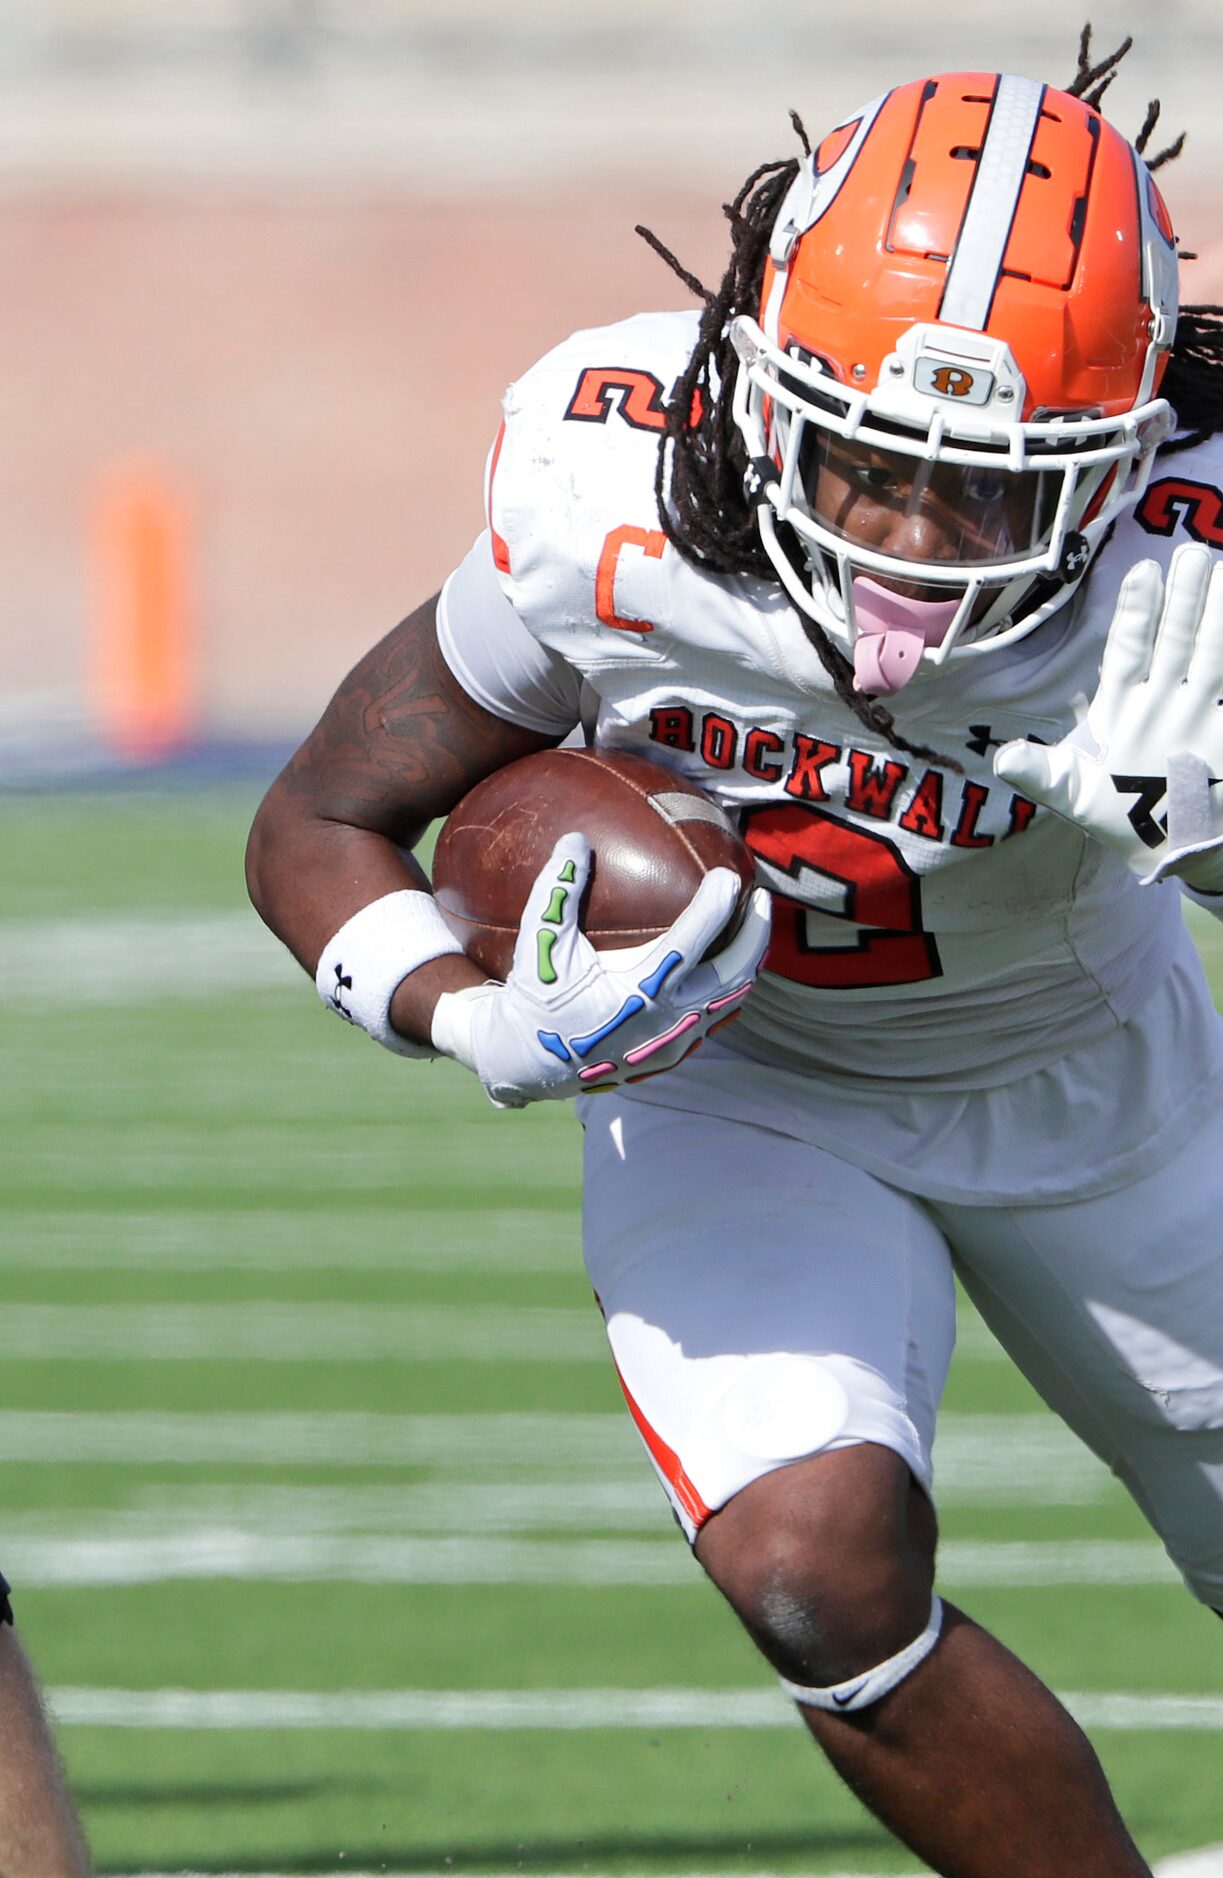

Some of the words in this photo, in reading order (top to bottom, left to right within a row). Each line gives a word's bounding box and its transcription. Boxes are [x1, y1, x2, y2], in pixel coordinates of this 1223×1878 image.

[563, 367, 704, 434] 2
[595, 524, 668, 634] C
[738, 800, 944, 991] 2
